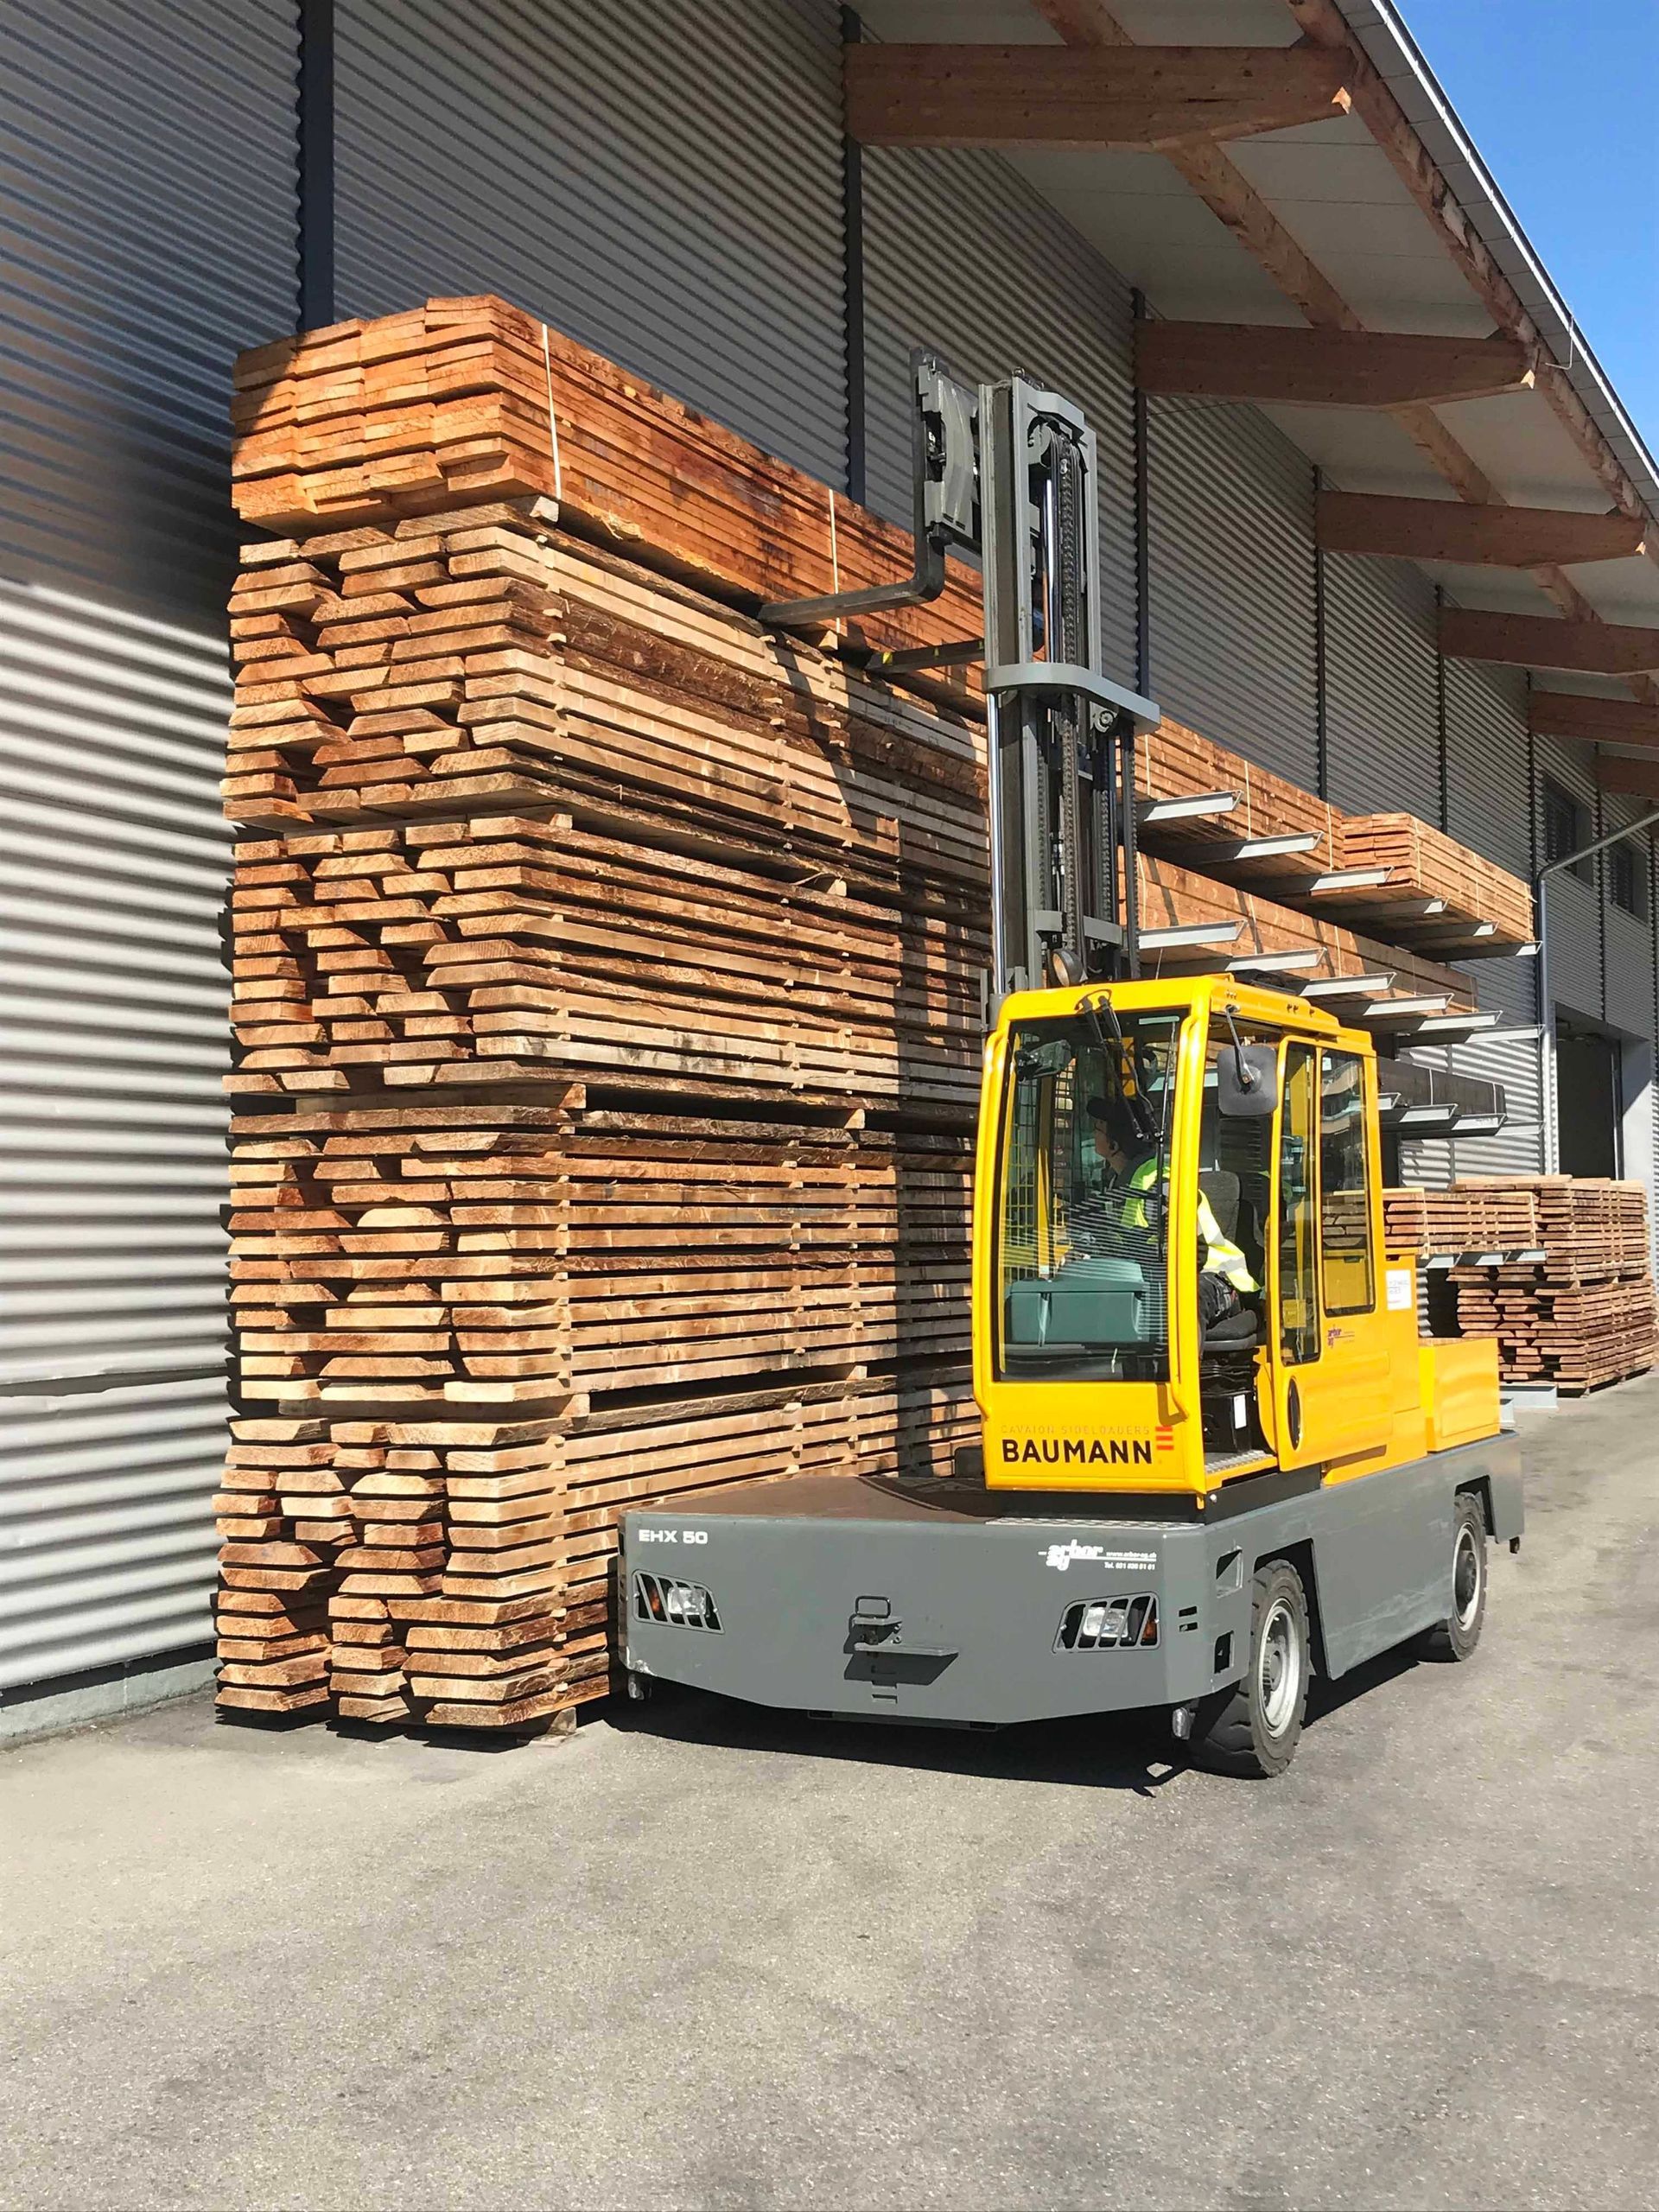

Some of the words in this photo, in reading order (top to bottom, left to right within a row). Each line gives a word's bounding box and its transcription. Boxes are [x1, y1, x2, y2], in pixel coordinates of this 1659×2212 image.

[1001, 1425, 1055, 1434] CAVAION
[1061, 1425, 1150, 1435] SIDELOADERS
[1002, 1439, 1153, 1465] BAUMANN
[639, 1529, 678, 1543] EHX
[683, 1530, 709, 1544] 50
[1048, 1539, 1103, 1556] arbor
